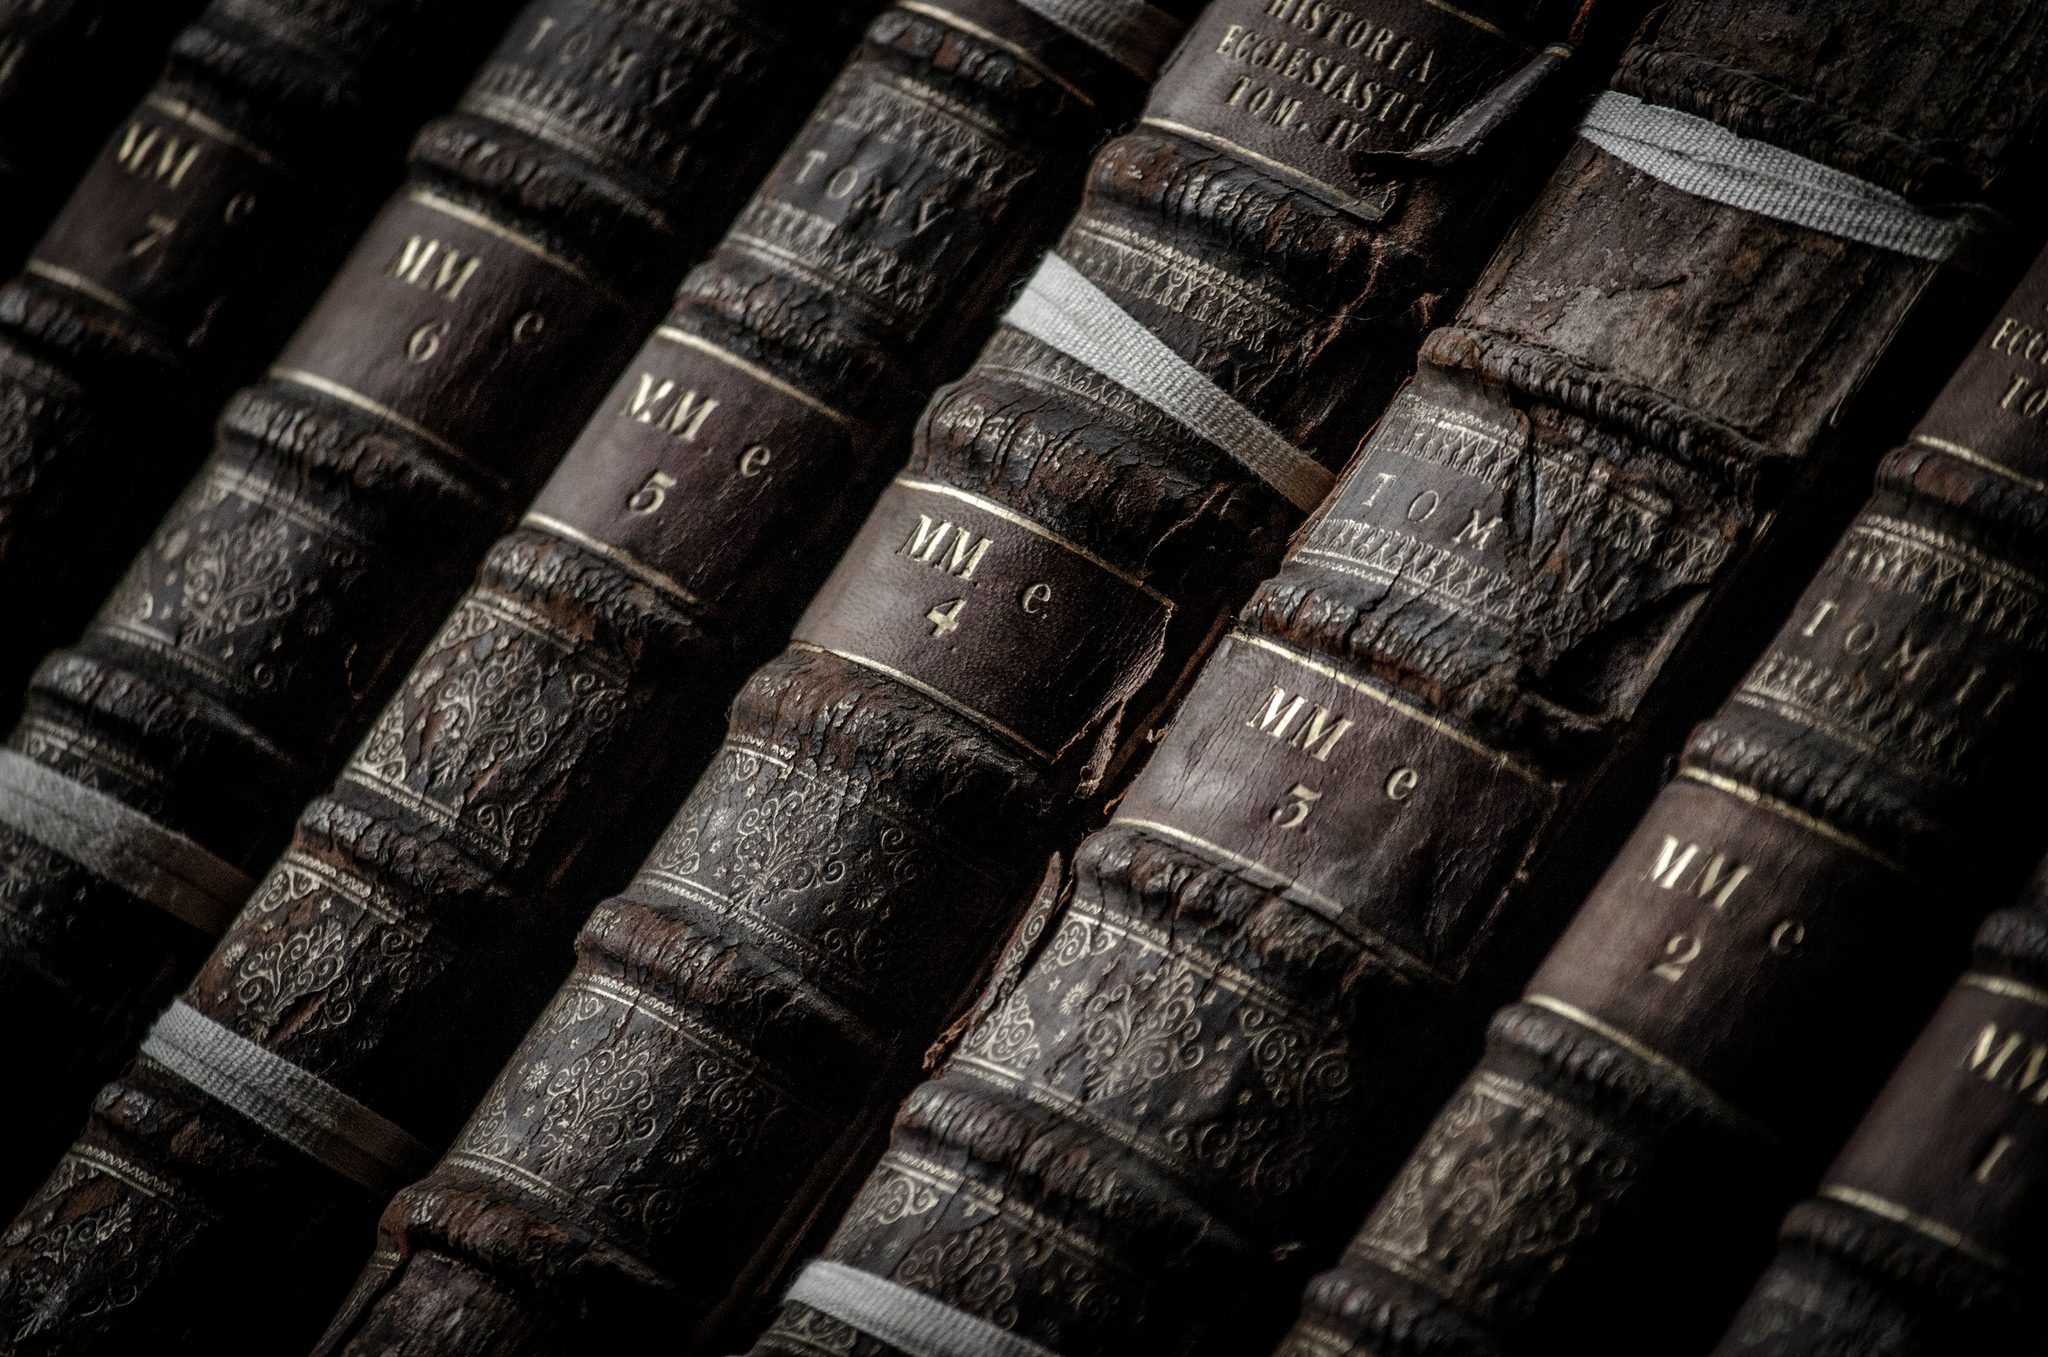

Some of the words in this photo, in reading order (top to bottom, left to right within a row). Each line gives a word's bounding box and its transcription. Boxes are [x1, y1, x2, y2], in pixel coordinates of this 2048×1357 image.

[129, 213, 179, 257] 7
[407, 319, 451, 364] 6
[629, 468, 678, 517] 5
[895, 513, 994, 582] MM
[925, 597, 967, 638] 4
[1245, 684, 1355, 763] MM
[1651, 934, 1701, 982] 2
